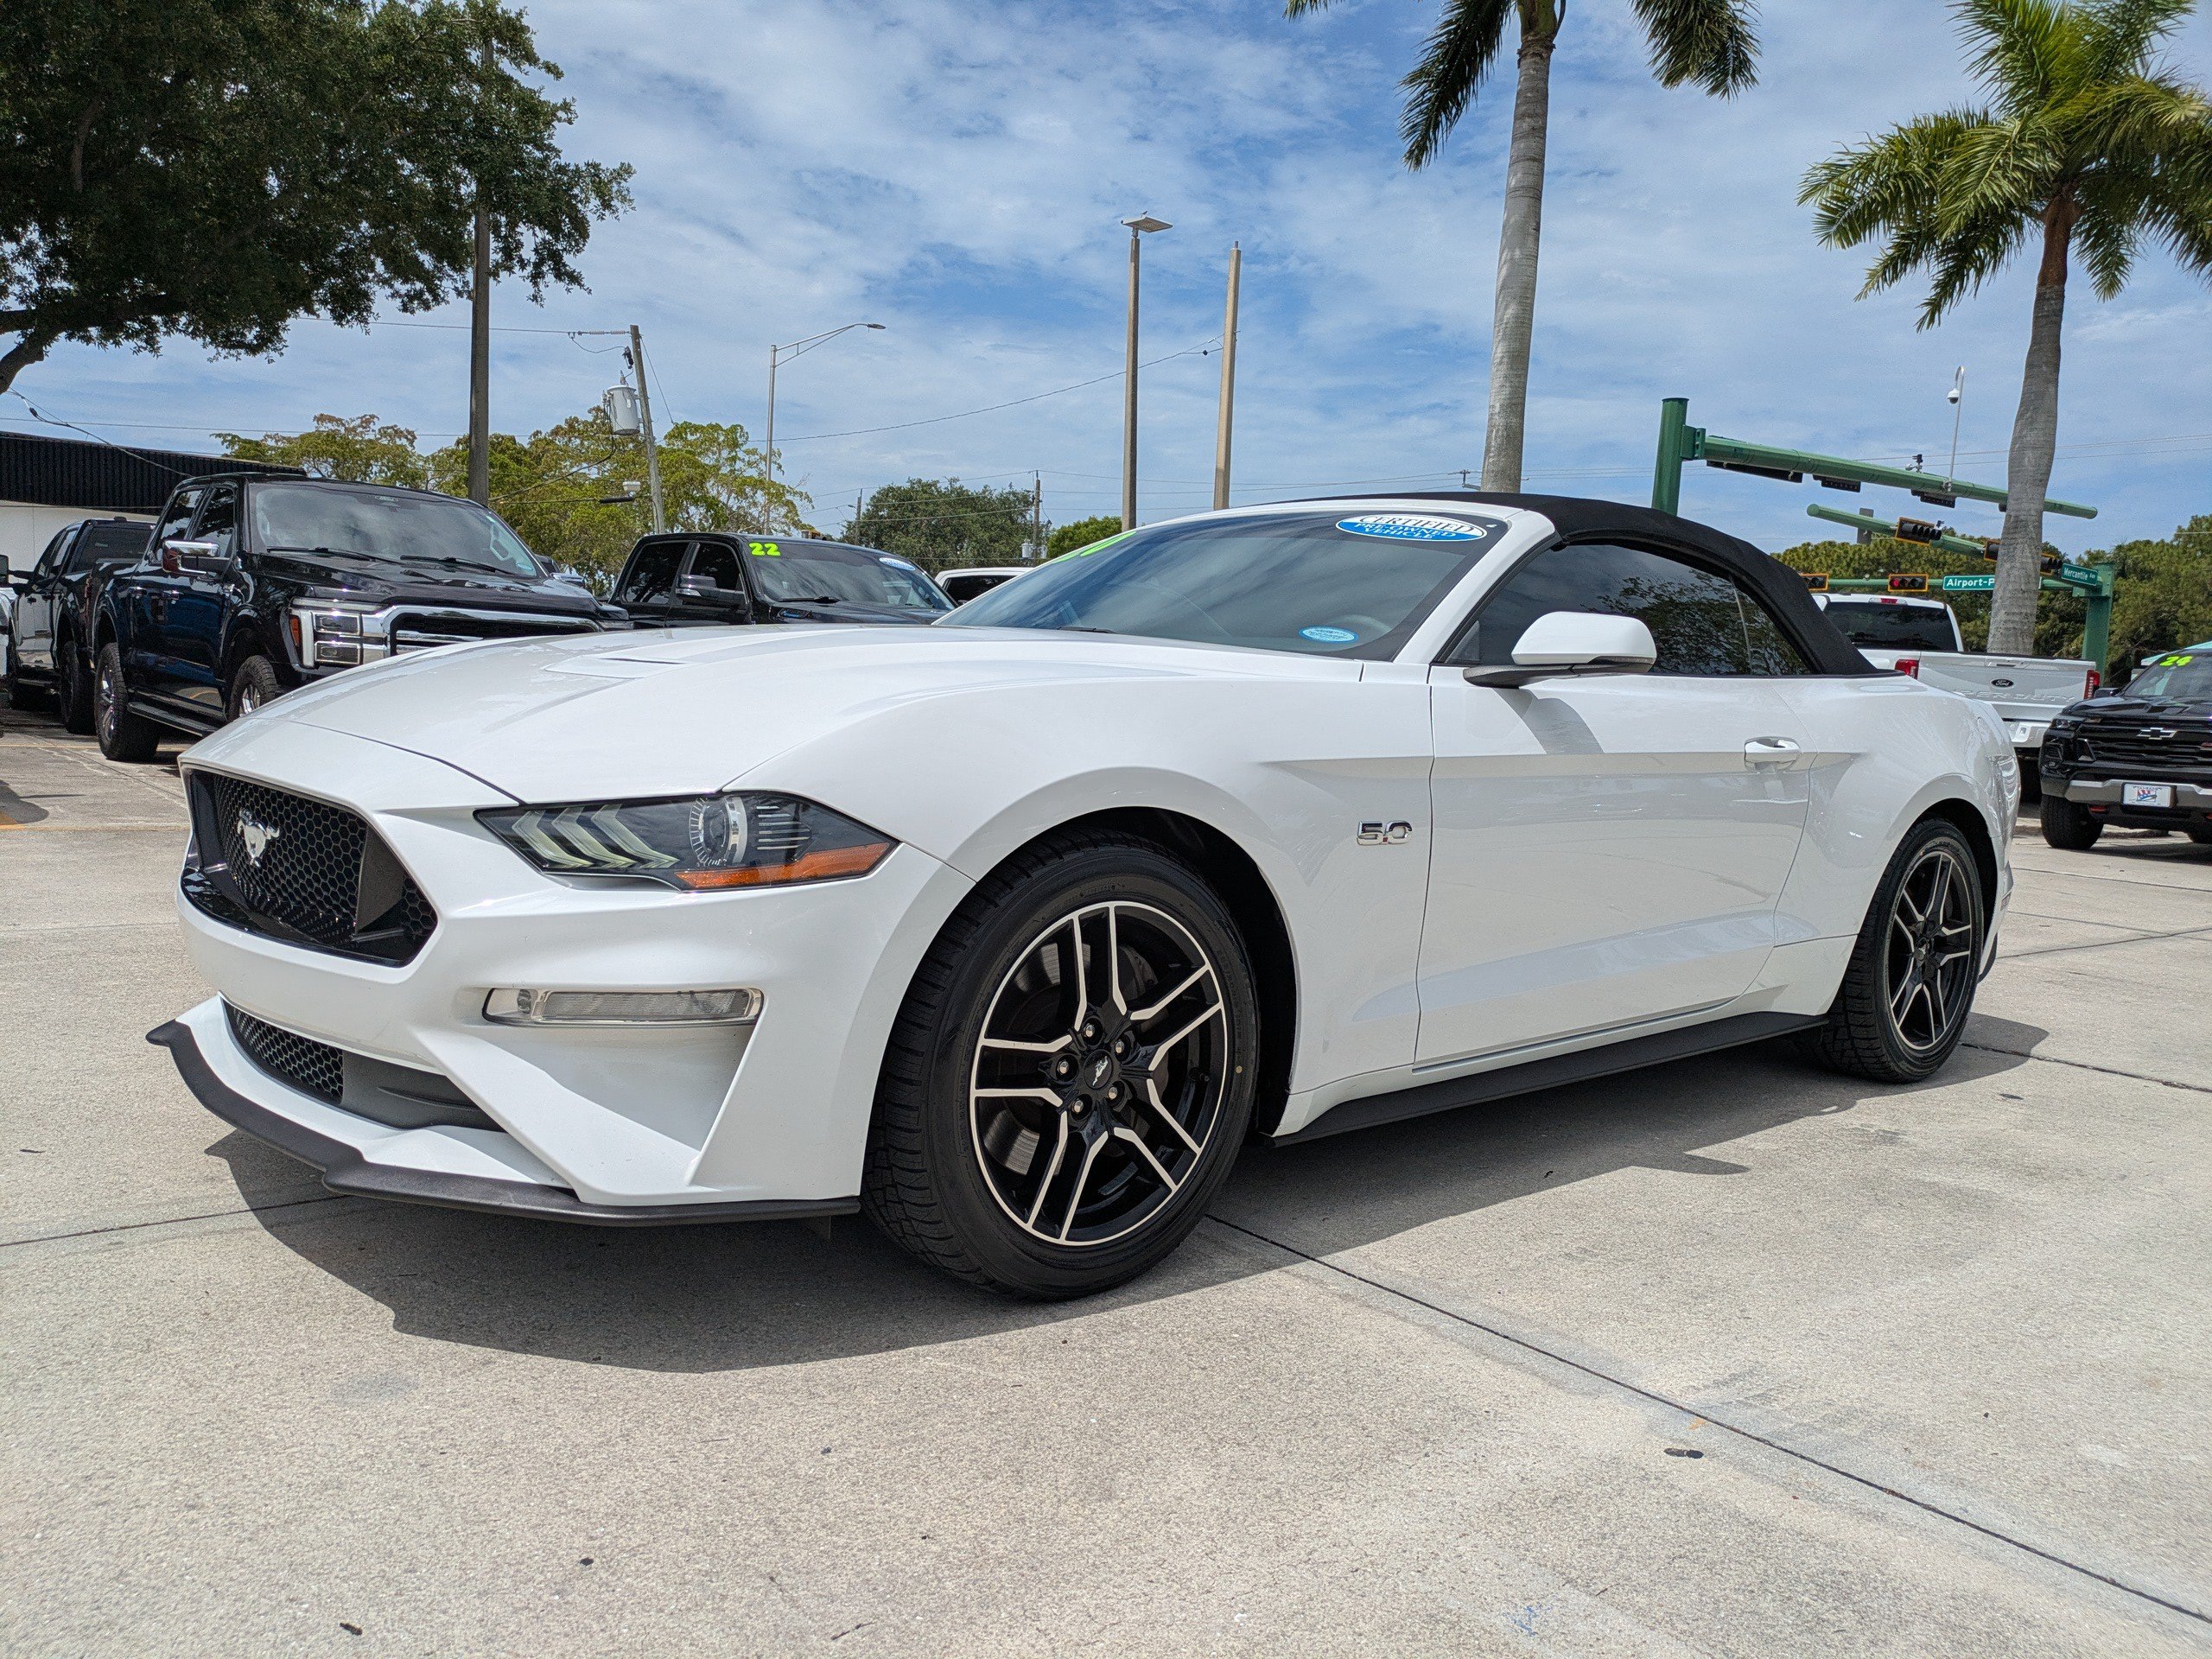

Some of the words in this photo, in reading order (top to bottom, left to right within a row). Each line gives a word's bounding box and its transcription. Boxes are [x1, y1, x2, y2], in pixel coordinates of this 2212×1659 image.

[1355, 523, 1457, 537] PRE-OWNED
[1359, 516, 1474, 533] CERTIFIED
[1364, 527, 1436, 539] VEHICLE
[748, 542, 781, 556] 22
[2063, 567, 2088, 580] Mercantile
[1946, 578, 1995, 588] Airport-P
[2159, 656, 2193, 666] 24
[2012, 692, 2075, 702] DUTY
[1356, 819, 1413, 846] 5.0
